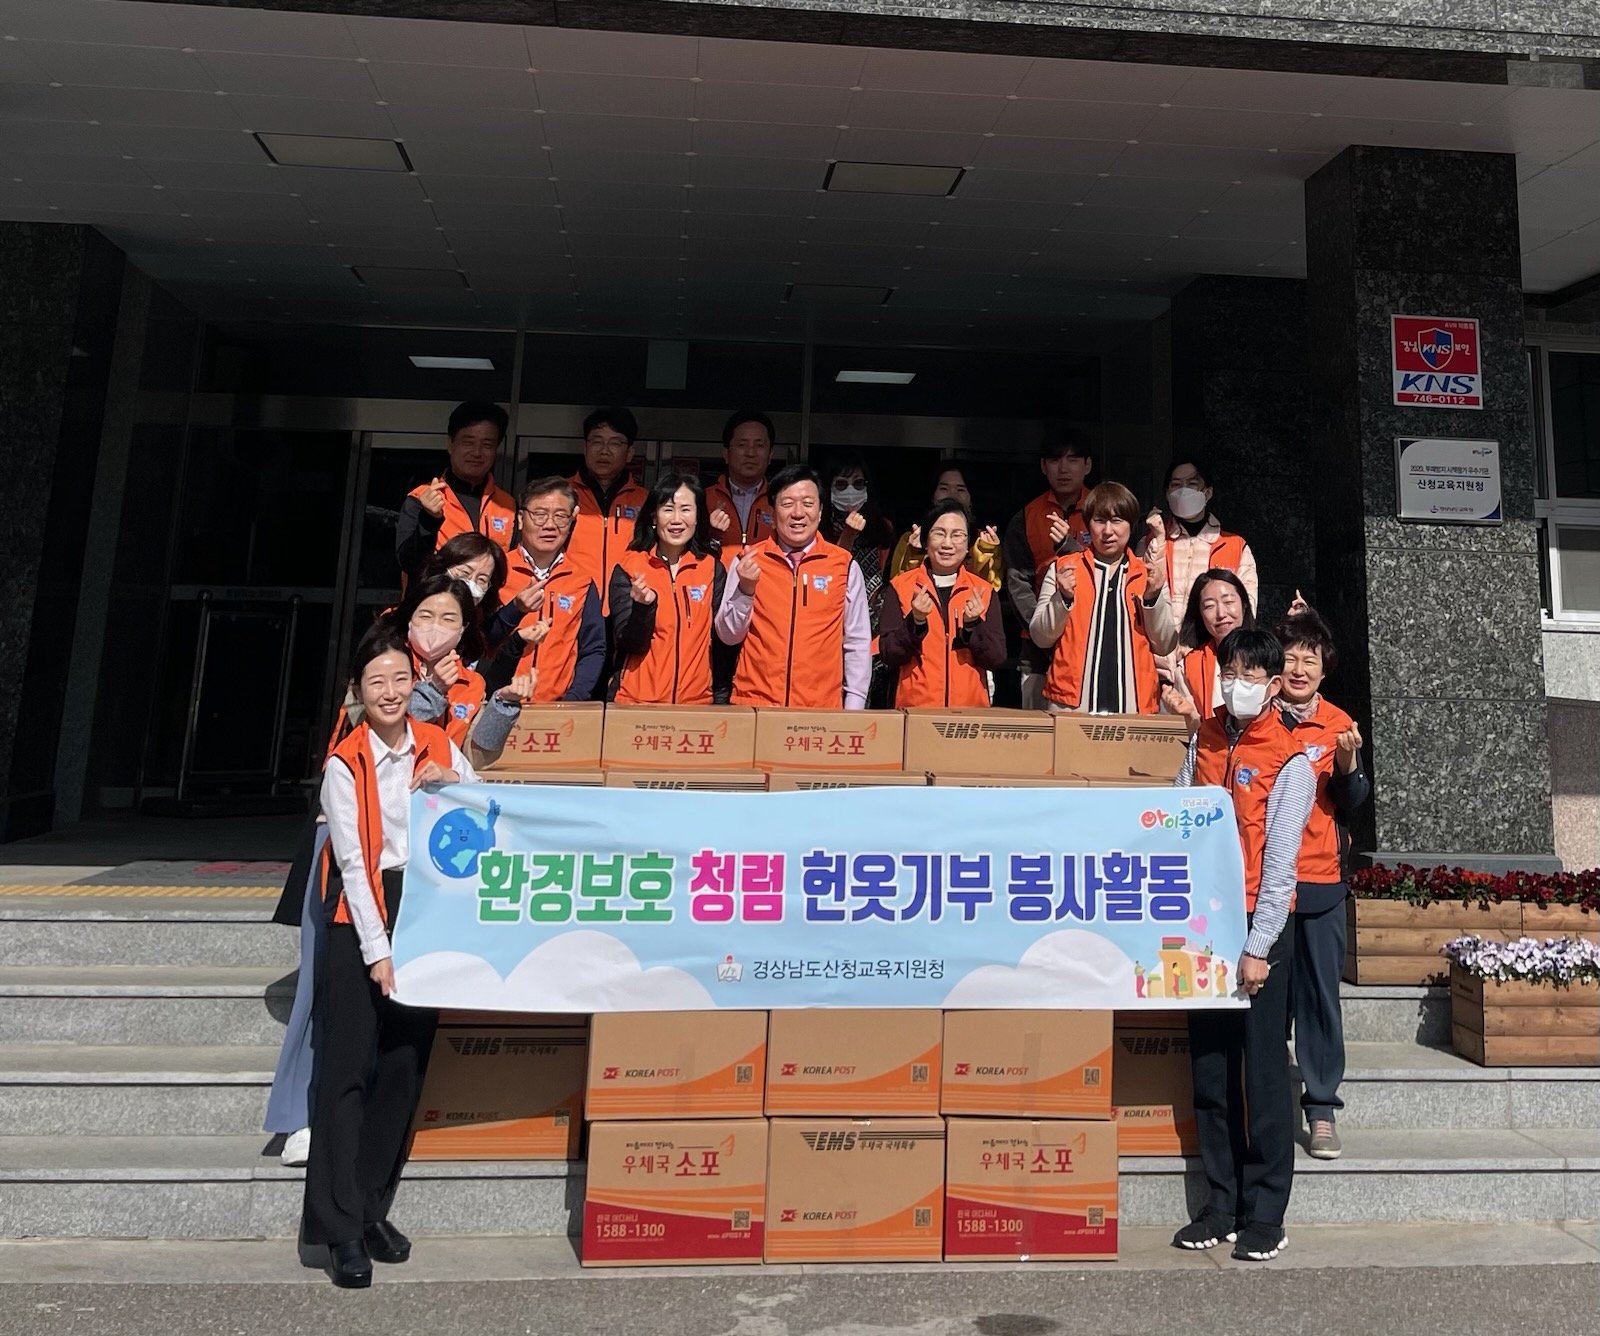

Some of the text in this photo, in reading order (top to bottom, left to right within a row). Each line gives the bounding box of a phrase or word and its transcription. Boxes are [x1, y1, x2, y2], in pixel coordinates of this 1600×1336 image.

[1422, 343, 1451, 355] KNS
[1400, 373, 1475, 395] KNS
[1413, 394, 1466, 405] 746-0112
[1417, 479, 1484, 492] 산청교육지원청
[945, 722, 980, 739] EMS
[1092, 725, 1127, 742] EMS
[521, 732, 561, 753] 소포
[632, 733, 715, 755] 우체국 소포
[784, 735, 866, 755] 우체국 소포
[1140, 806, 1224, 840] 아이좋아
[477, 849, 1192, 922] 환경보호 청렴 헌옷기부 봉사활동
[752, 958, 945, 980] 경상남도산청교육지원청
[461, 1037, 502, 1056] EMS
[1133, 1037, 1170, 1055] EMS
[625, 1068, 680, 1078] KOREA POST
[802, 1065, 857, 1075] KOREA POST
[975, 1066, 1029, 1076] KOREA POST
[445, 1111, 475, 1121] KOREA
[1124, 1109, 1172, 1118] KOREA POST
[815, 1131, 857, 1151] EMS
[622, 1151, 721, 1177] 우체국 소포
[980, 1148, 1074, 1174] 우체국 소포
[802, 1210, 858, 1221] KOREA POST
[596, 1223, 666, 1238] 1588-1300
[957, 1219, 1023, 1233] 1588-1300
